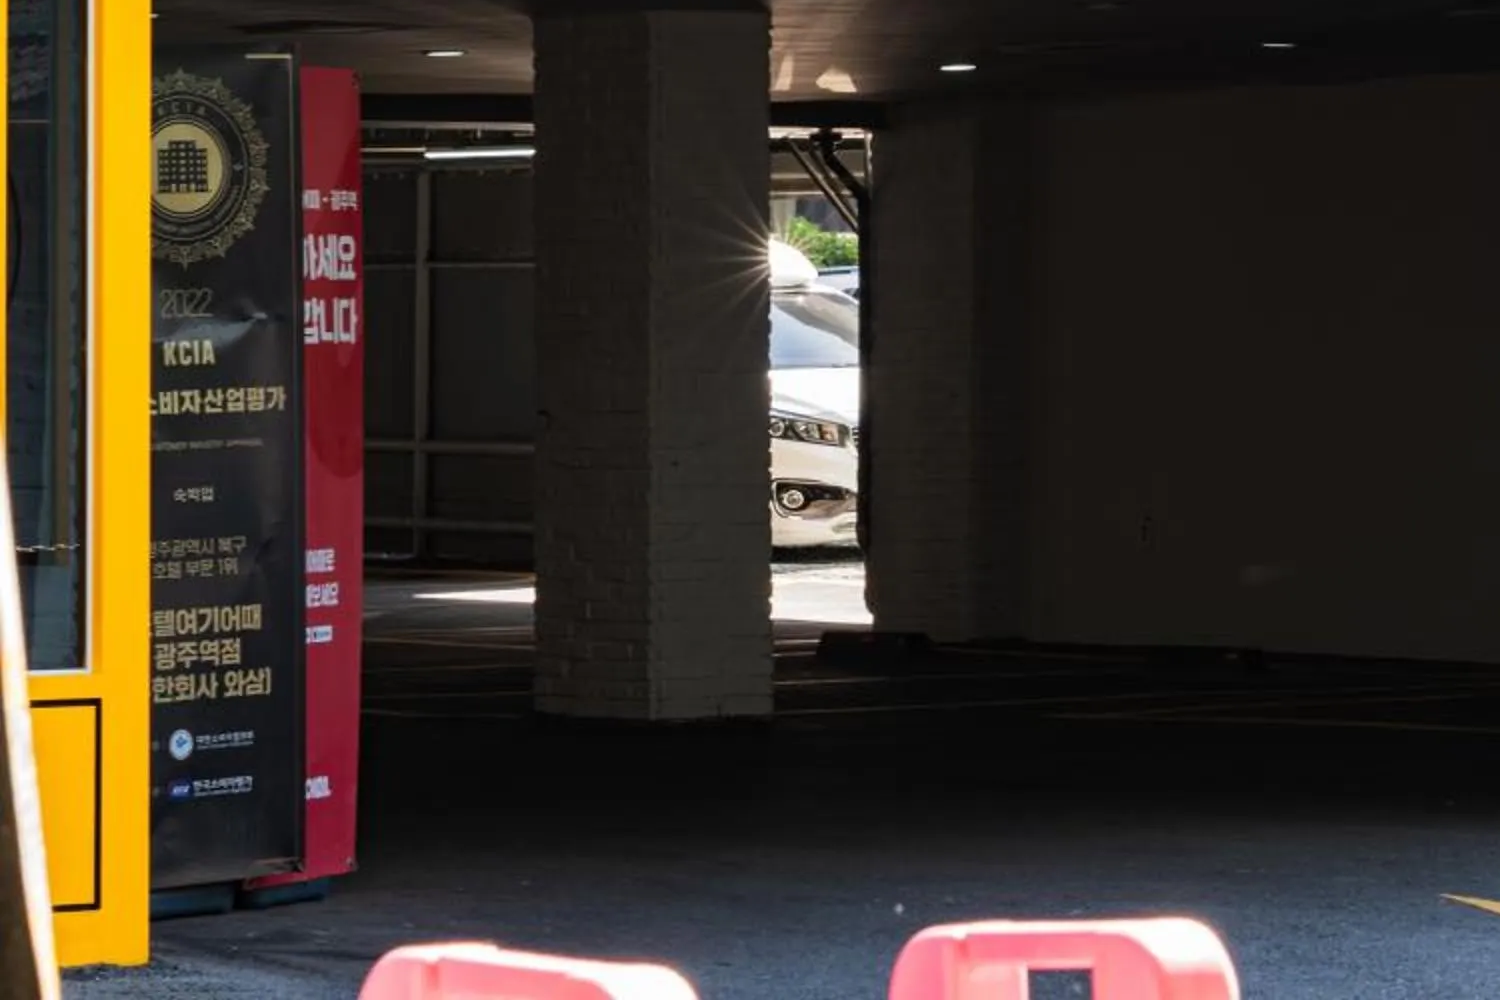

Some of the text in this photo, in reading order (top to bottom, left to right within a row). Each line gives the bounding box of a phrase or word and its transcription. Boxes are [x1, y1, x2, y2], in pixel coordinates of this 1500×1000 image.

[160, 288, 215, 319] 2022
[163, 339, 217, 367] KCIA
[149, 603, 263, 637] 텔여기어때
[154, 637, 242, 671] 광주역점
